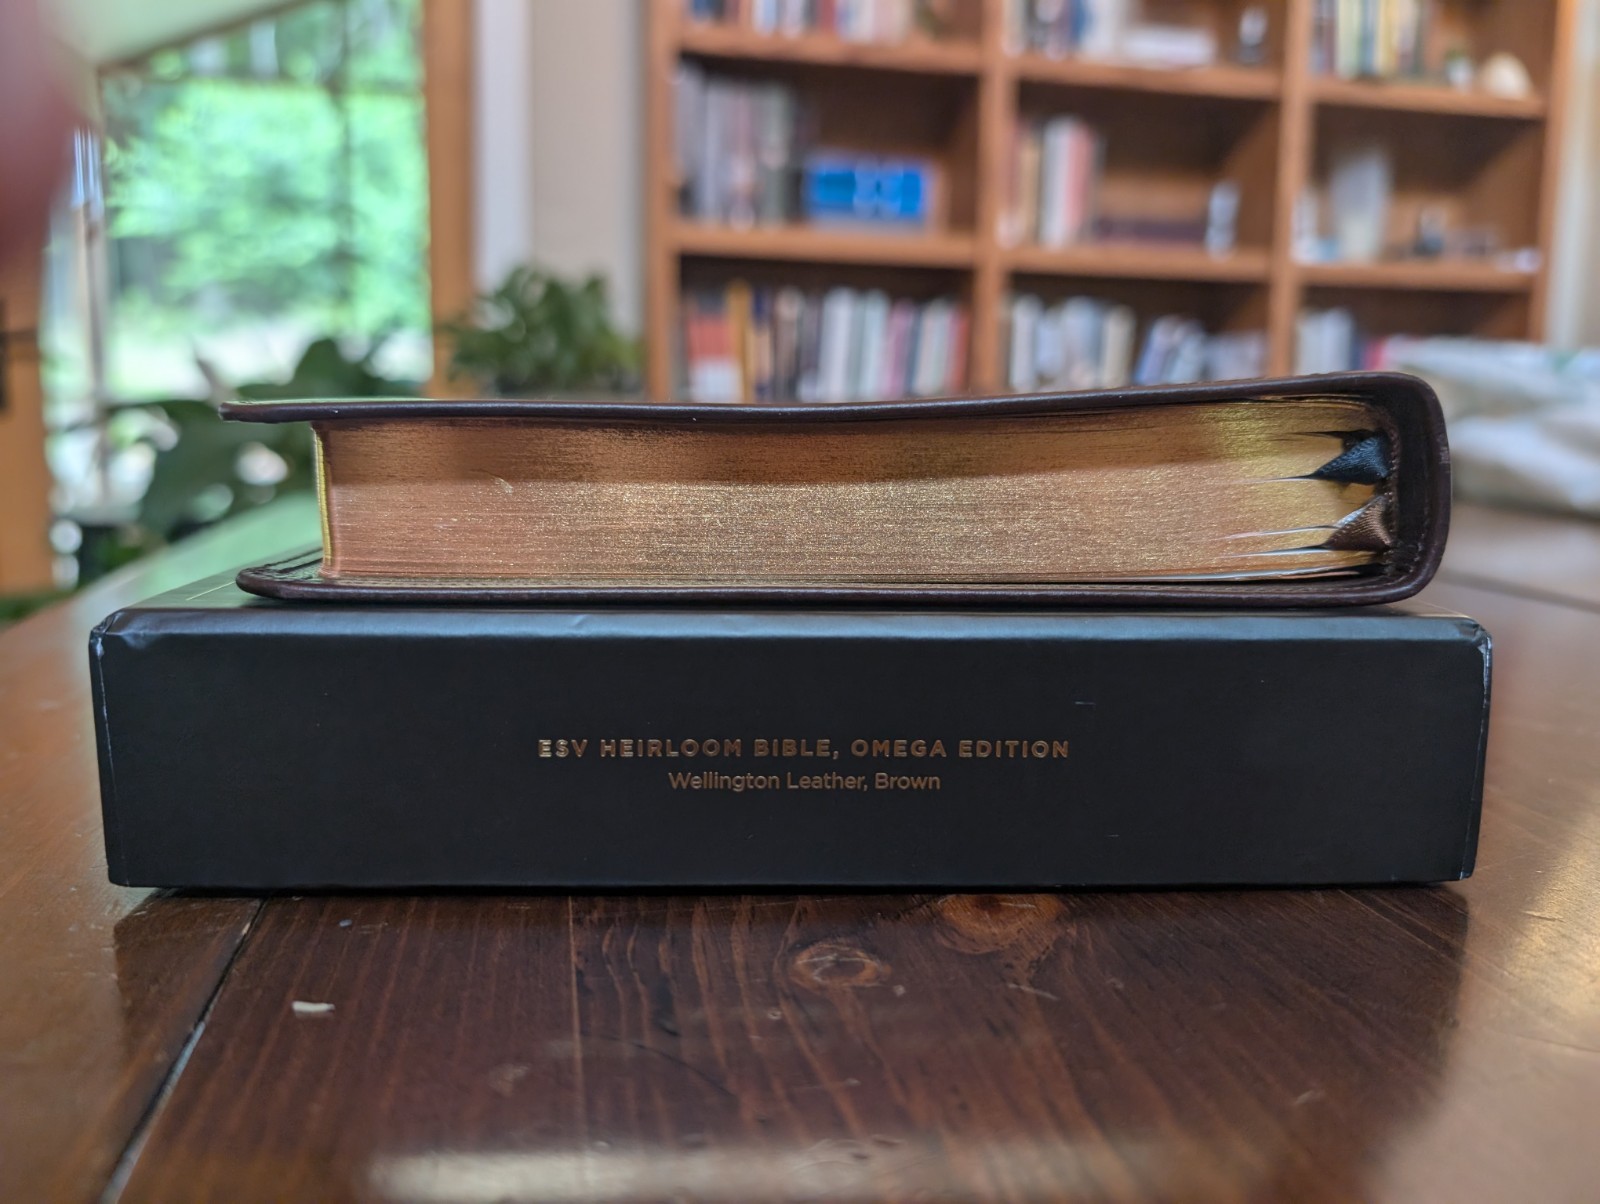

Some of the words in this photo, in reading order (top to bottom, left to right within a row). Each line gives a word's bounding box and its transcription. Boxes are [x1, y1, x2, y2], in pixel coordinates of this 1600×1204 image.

[538, 738, 588, 758] ESV
[600, 738, 741, 758] HEIRLOOM
[754, 738, 839, 760] BIBLE,
[851, 739, 947, 758] OMEGA
[958, 739, 1069, 759] EDITION
[668, 771, 780, 792] Wellington
[787, 771, 868, 791] Leather,
[875, 772, 940, 790] Brown
